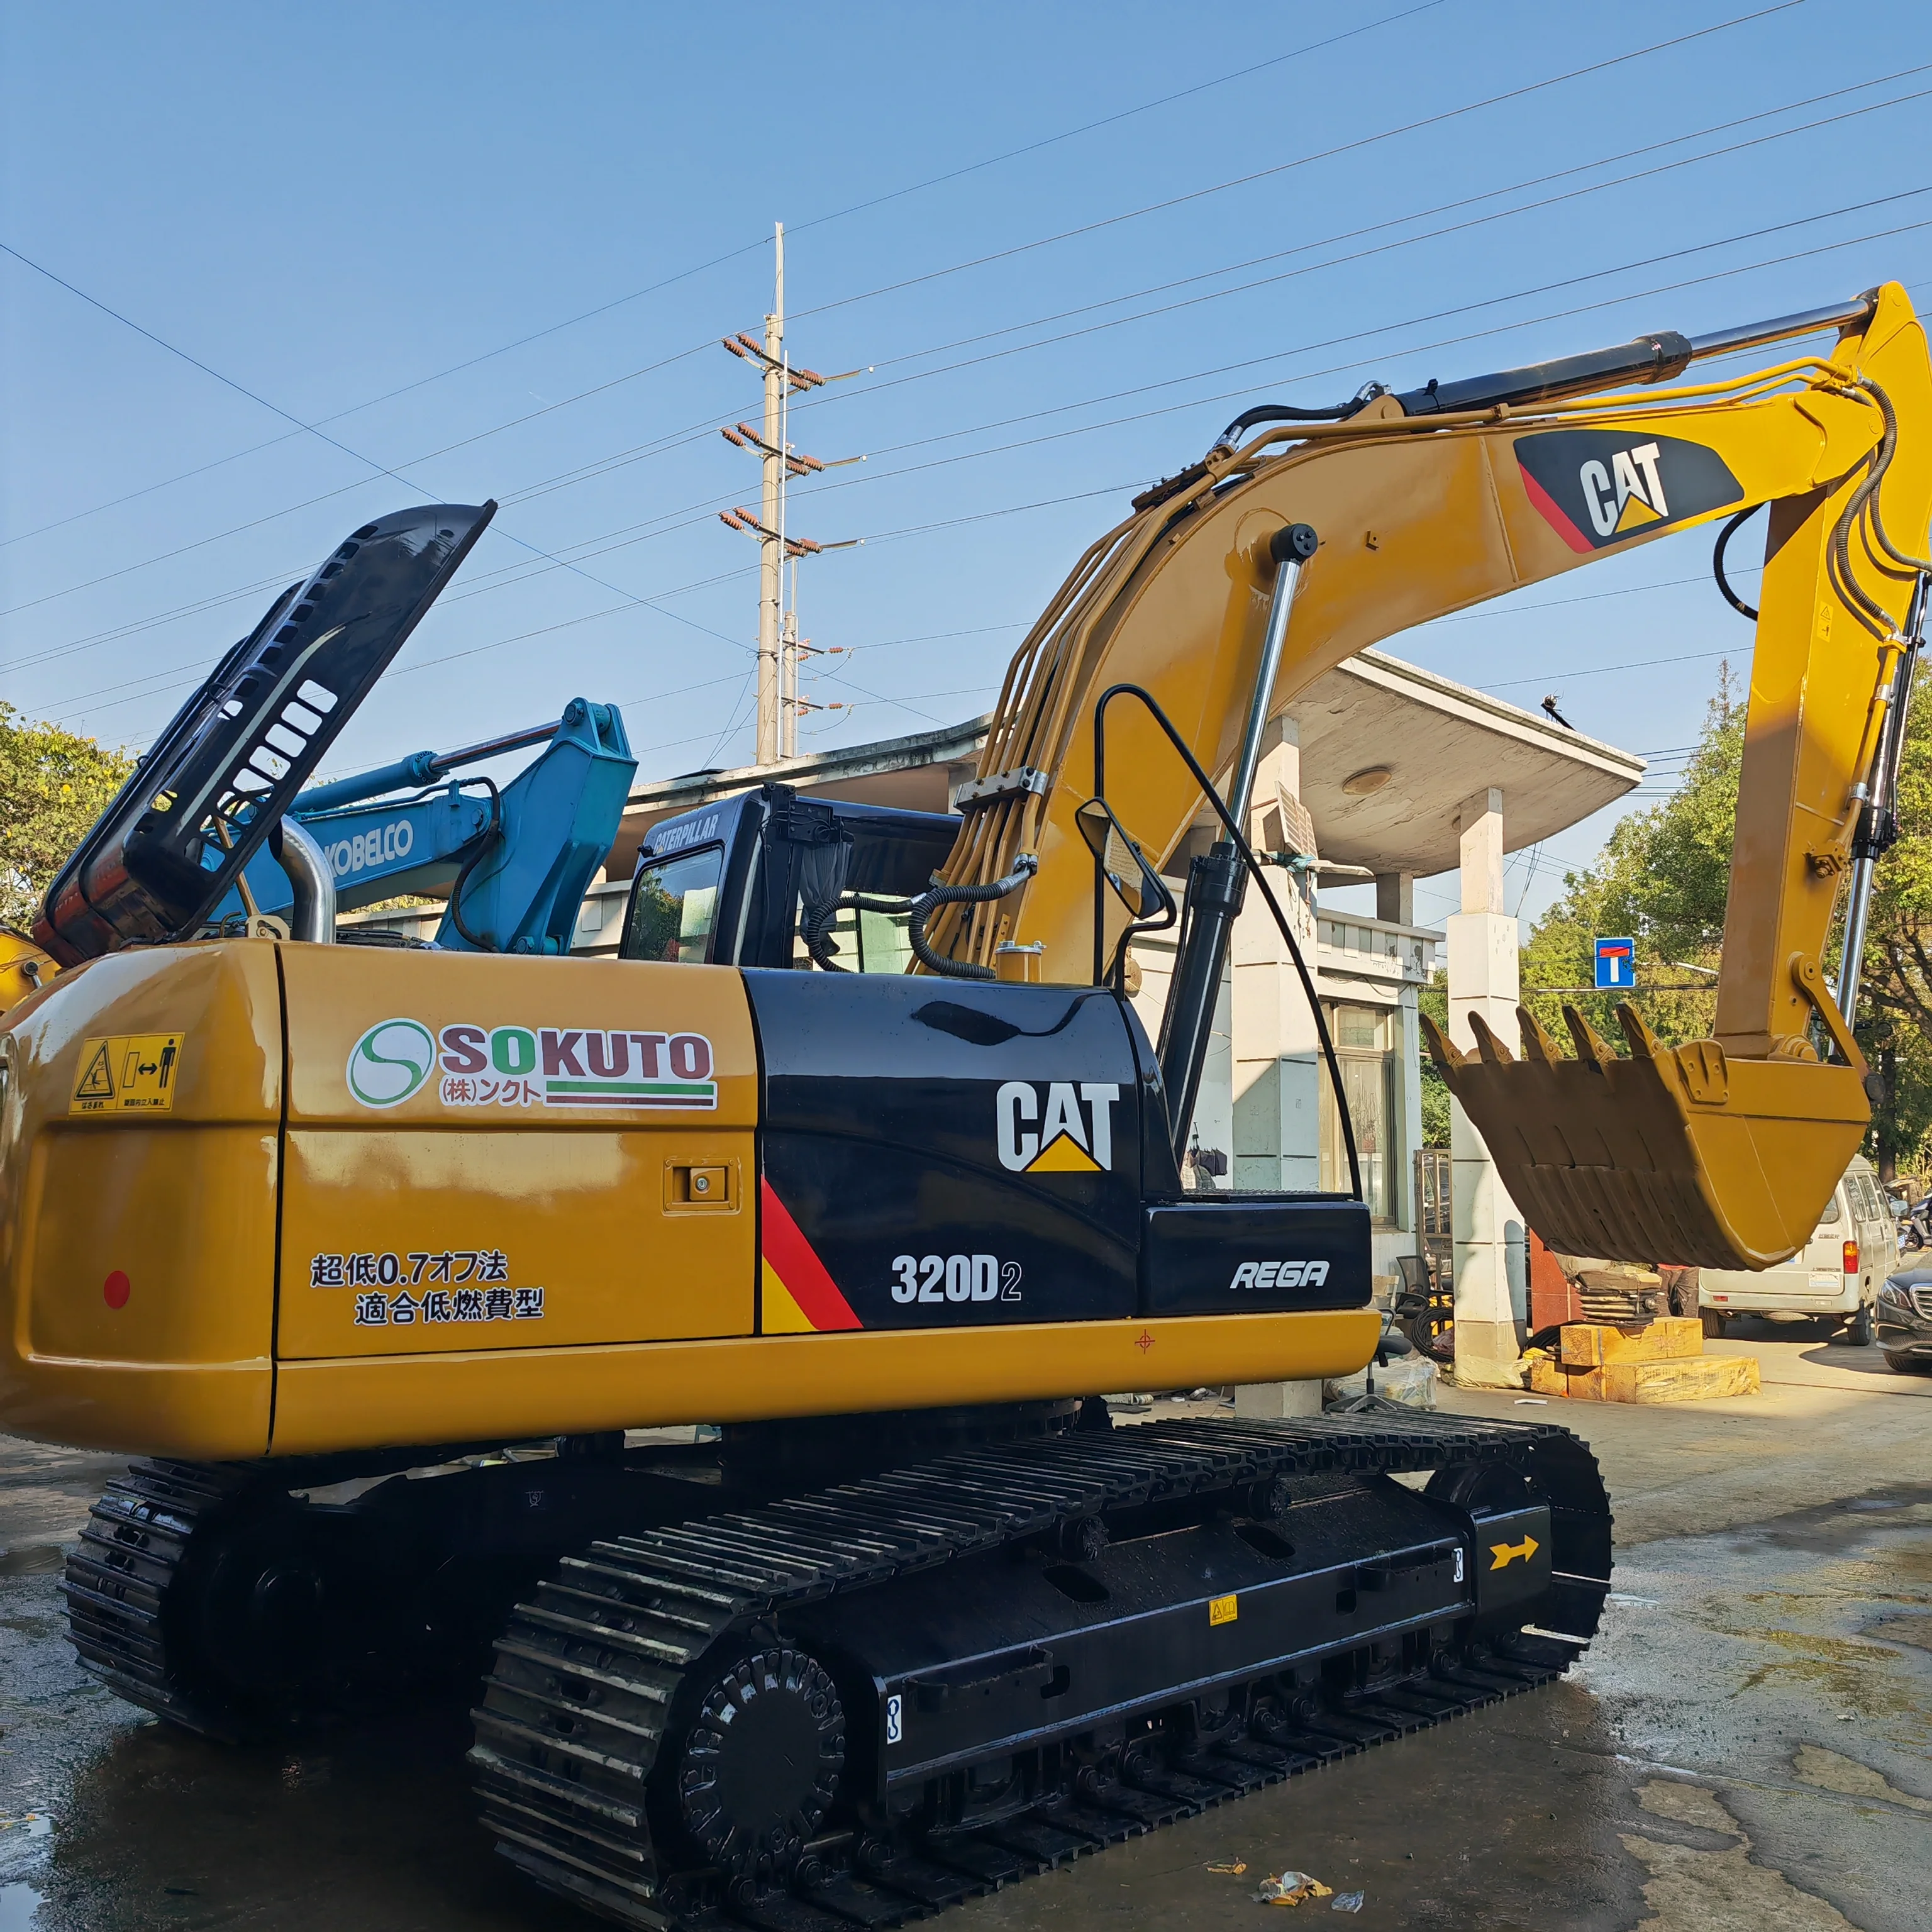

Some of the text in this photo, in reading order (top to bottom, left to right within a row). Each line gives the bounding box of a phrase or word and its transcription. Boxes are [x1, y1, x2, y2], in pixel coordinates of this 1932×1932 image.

[1579, 441, 1669, 537] CAT
[653, 813, 719, 855] CATERPILLAR
[441, 1026, 711, 1080] SOKUTO
[996, 1082, 1119, 1172] CAT
[1230, 1260, 1330, 1289] REGA
[354, 1287, 545, 1326] 適合低燃費型
